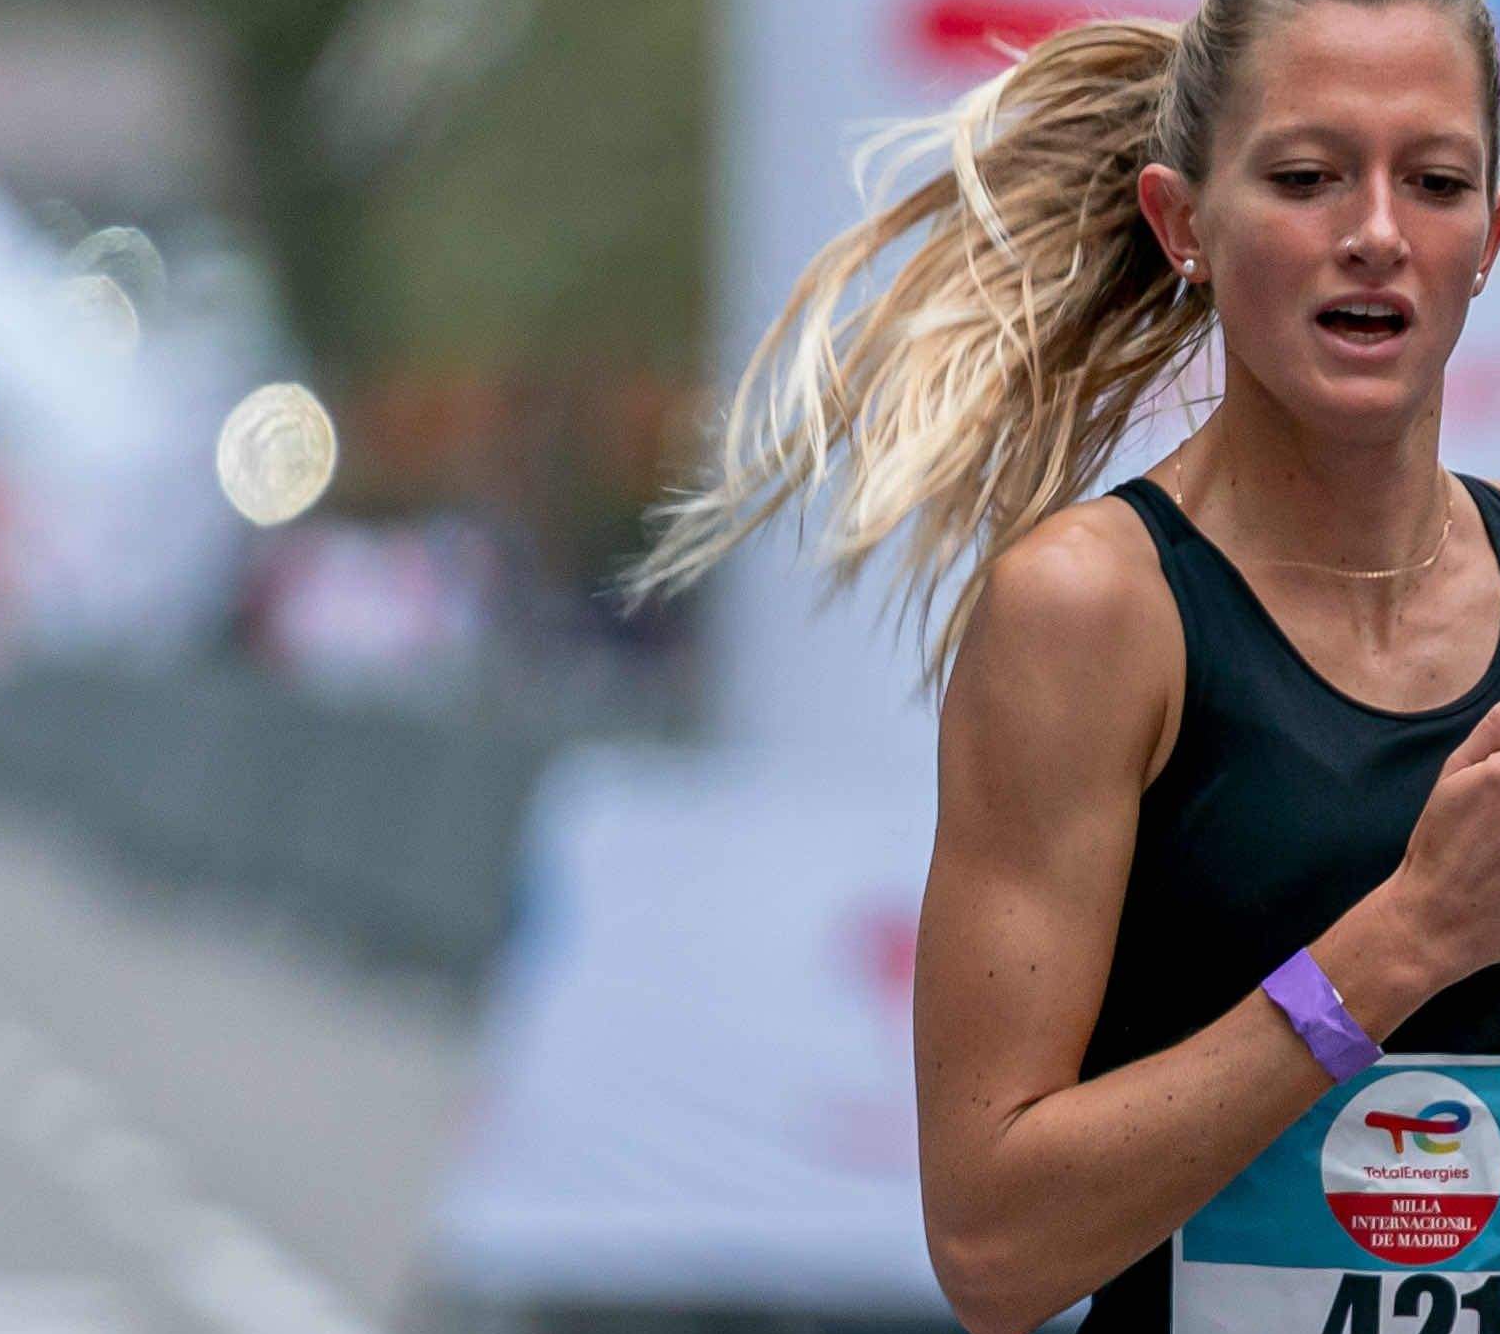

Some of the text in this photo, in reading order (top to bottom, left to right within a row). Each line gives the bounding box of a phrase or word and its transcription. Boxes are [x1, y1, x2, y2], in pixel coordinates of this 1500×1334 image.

[1363, 1165, 1470, 1183] TotalEnergies
[1392, 1199, 1442, 1214] MILLA
[1371, 1233, 1460, 1248] DE MADRID
